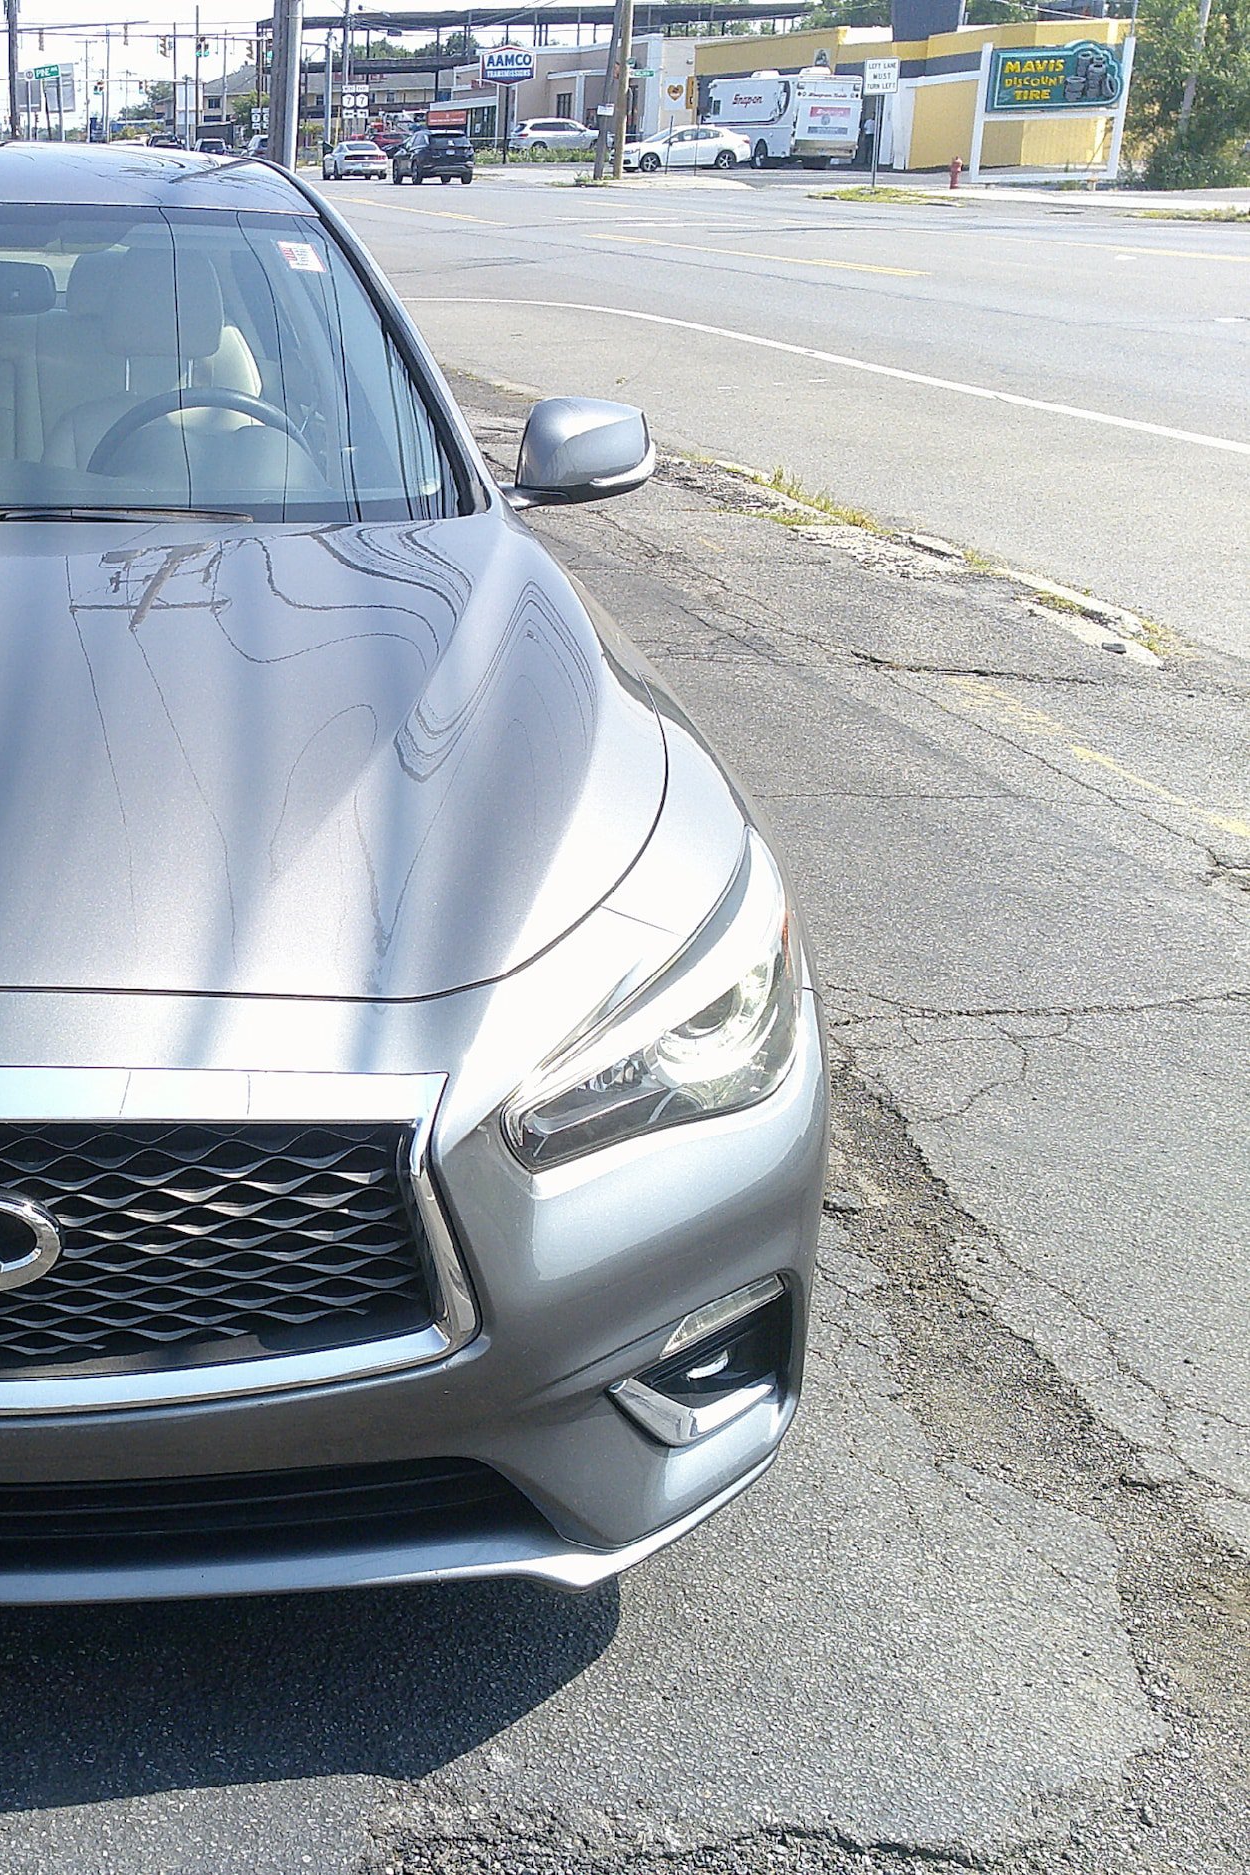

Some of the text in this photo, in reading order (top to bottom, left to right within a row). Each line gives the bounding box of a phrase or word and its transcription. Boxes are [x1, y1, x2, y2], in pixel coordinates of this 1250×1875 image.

[487, 54, 532, 67] AAMCO
[1004, 59, 1065, 73] MAVIS
[873, 72, 891, 80] MUST
[1005, 75, 1066, 88] DISCOUNT
[882, 82, 896, 90] LEFT
[1014, 89, 1051, 100] TIRE
